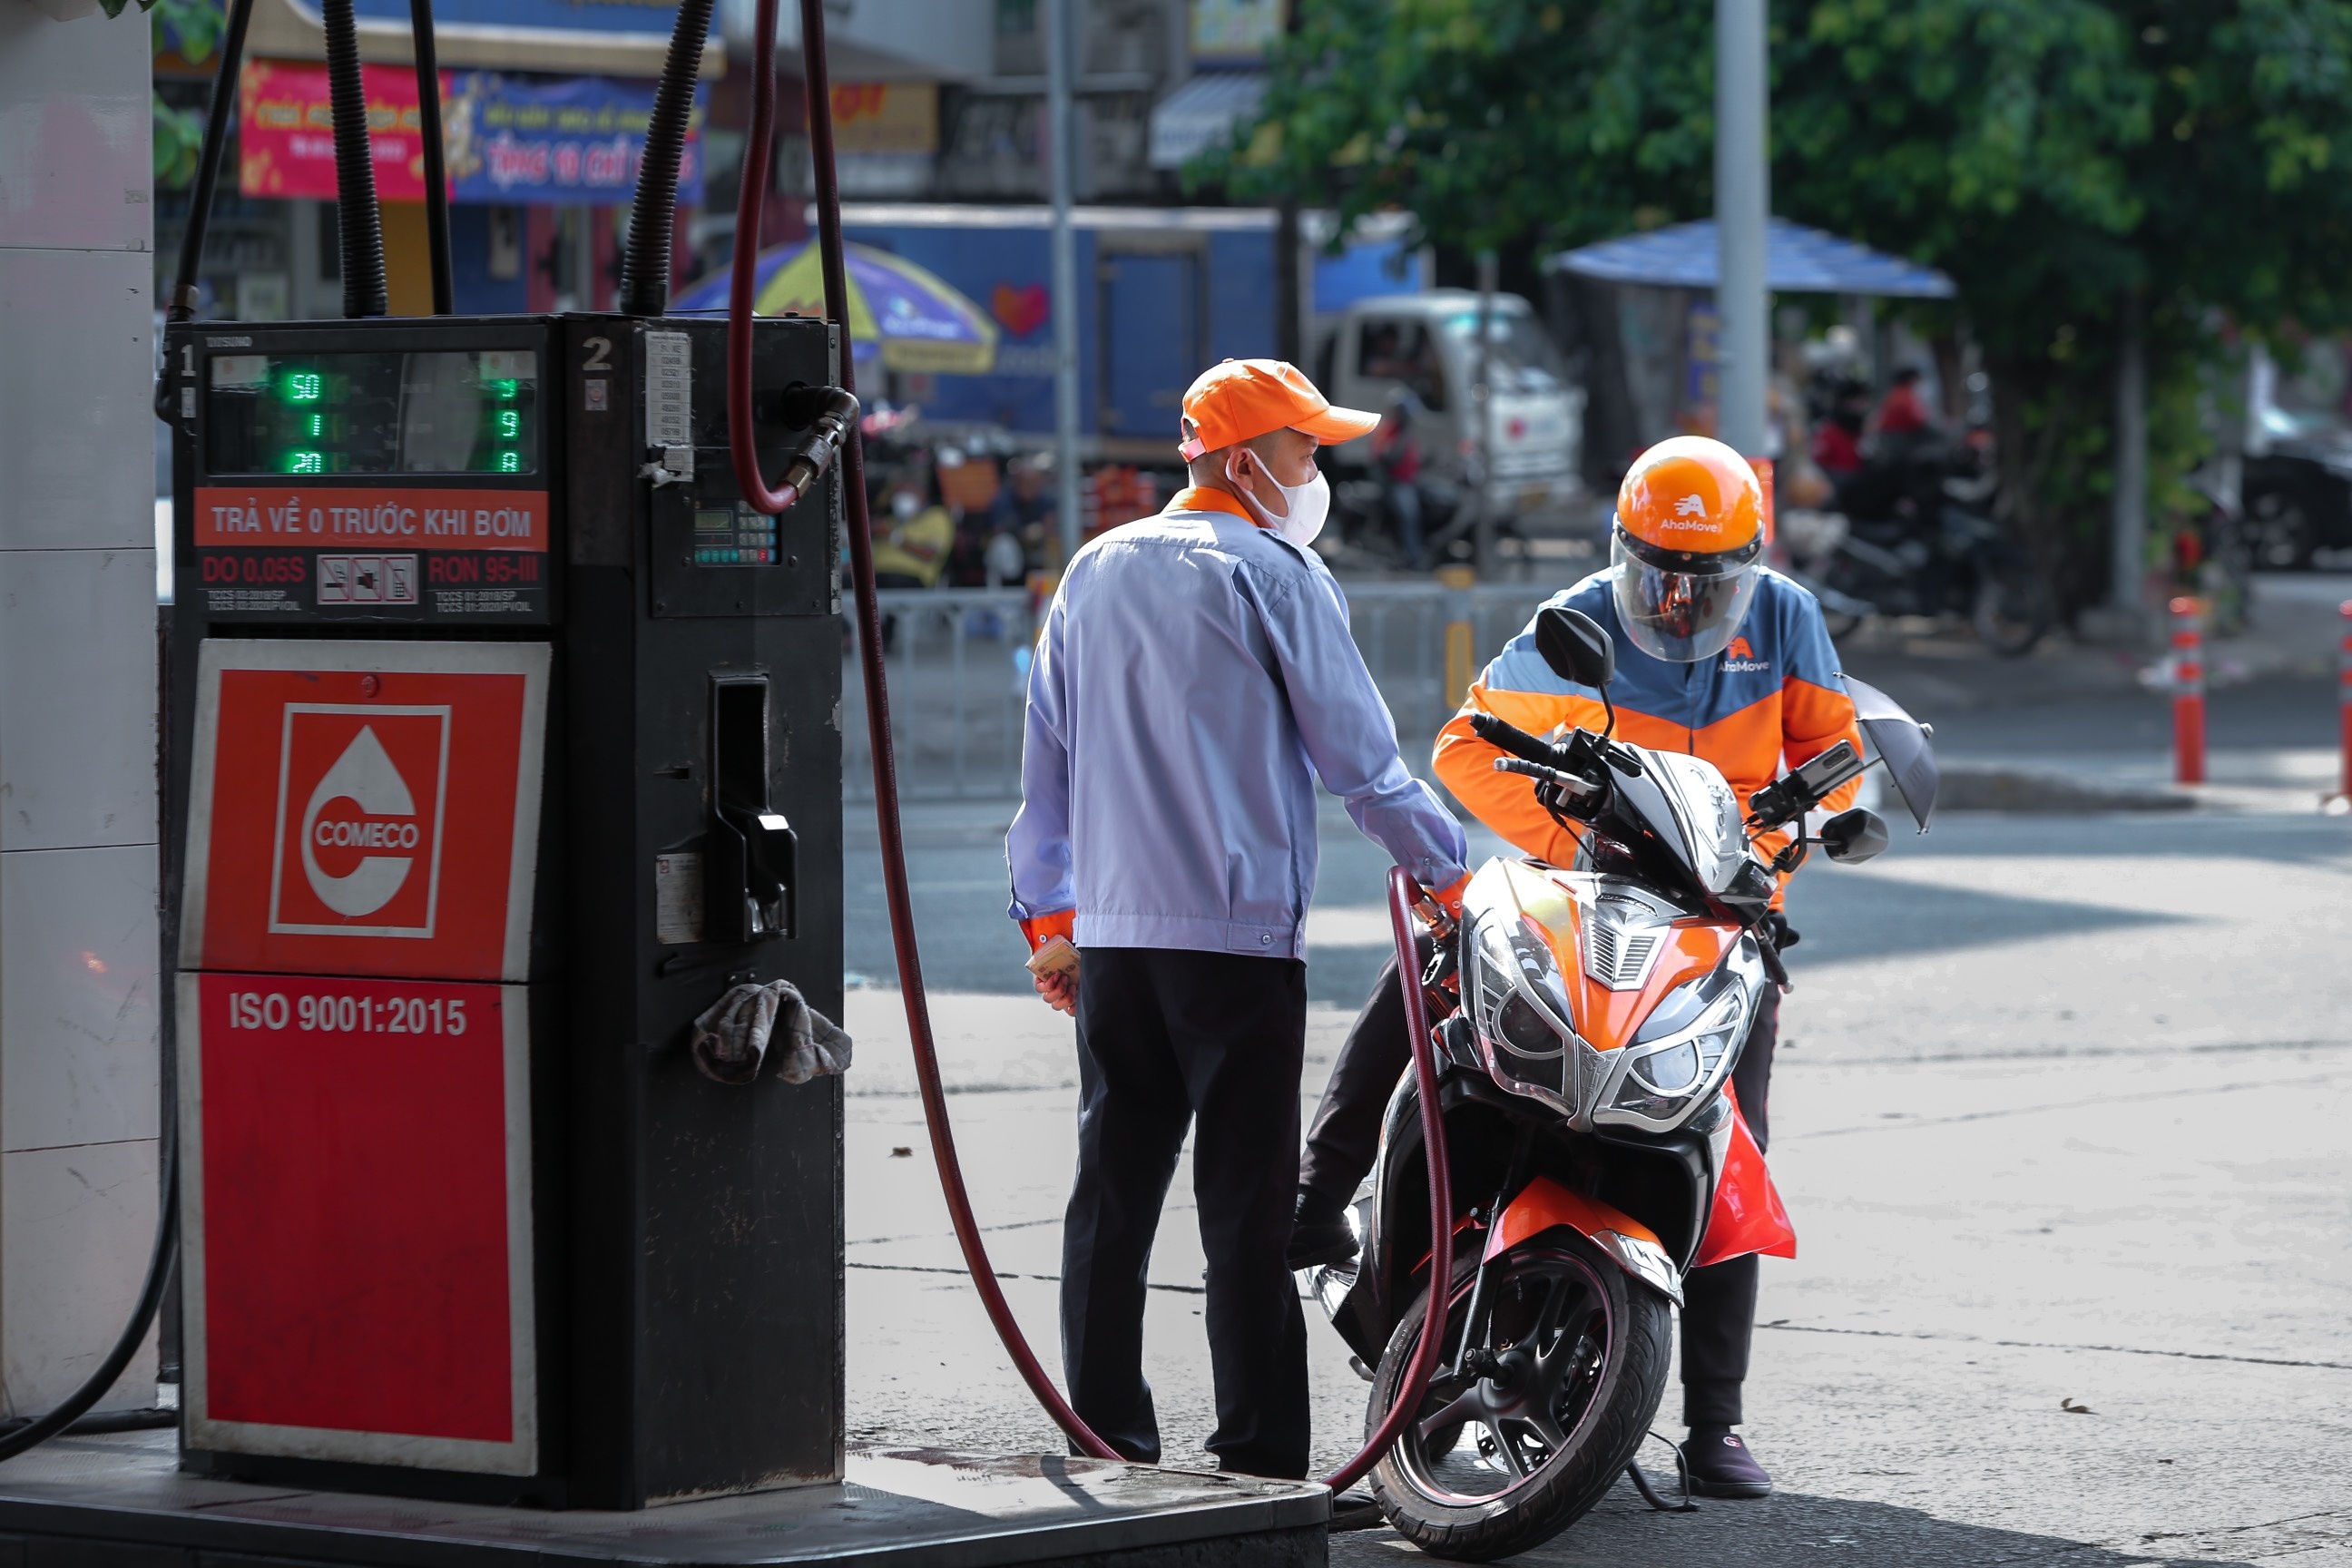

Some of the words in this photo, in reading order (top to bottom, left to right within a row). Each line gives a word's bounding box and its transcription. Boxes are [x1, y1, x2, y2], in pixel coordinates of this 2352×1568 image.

[582, 337, 612, 371] 2
[211, 497, 261, 533] TRẢ
[268, 496, 301, 533] VỀ
[309, 507, 324, 533] 0
[328, 502, 416, 534] TRƯỚC
[424, 509, 467, 535] KHI
[475, 506, 532, 537] BƠM
[1660, 518, 1719, 533] AhaMove
[202, 556, 240, 583] DO
[428, 555, 480, 583] RON
[485, 555, 539, 583] 95-III
[1718, 660, 1769, 672] AhaMove
[315, 820, 420, 849] COMECO
[230, 992, 290, 1030] ISO
[298, 995, 468, 1035] 9001:2015
